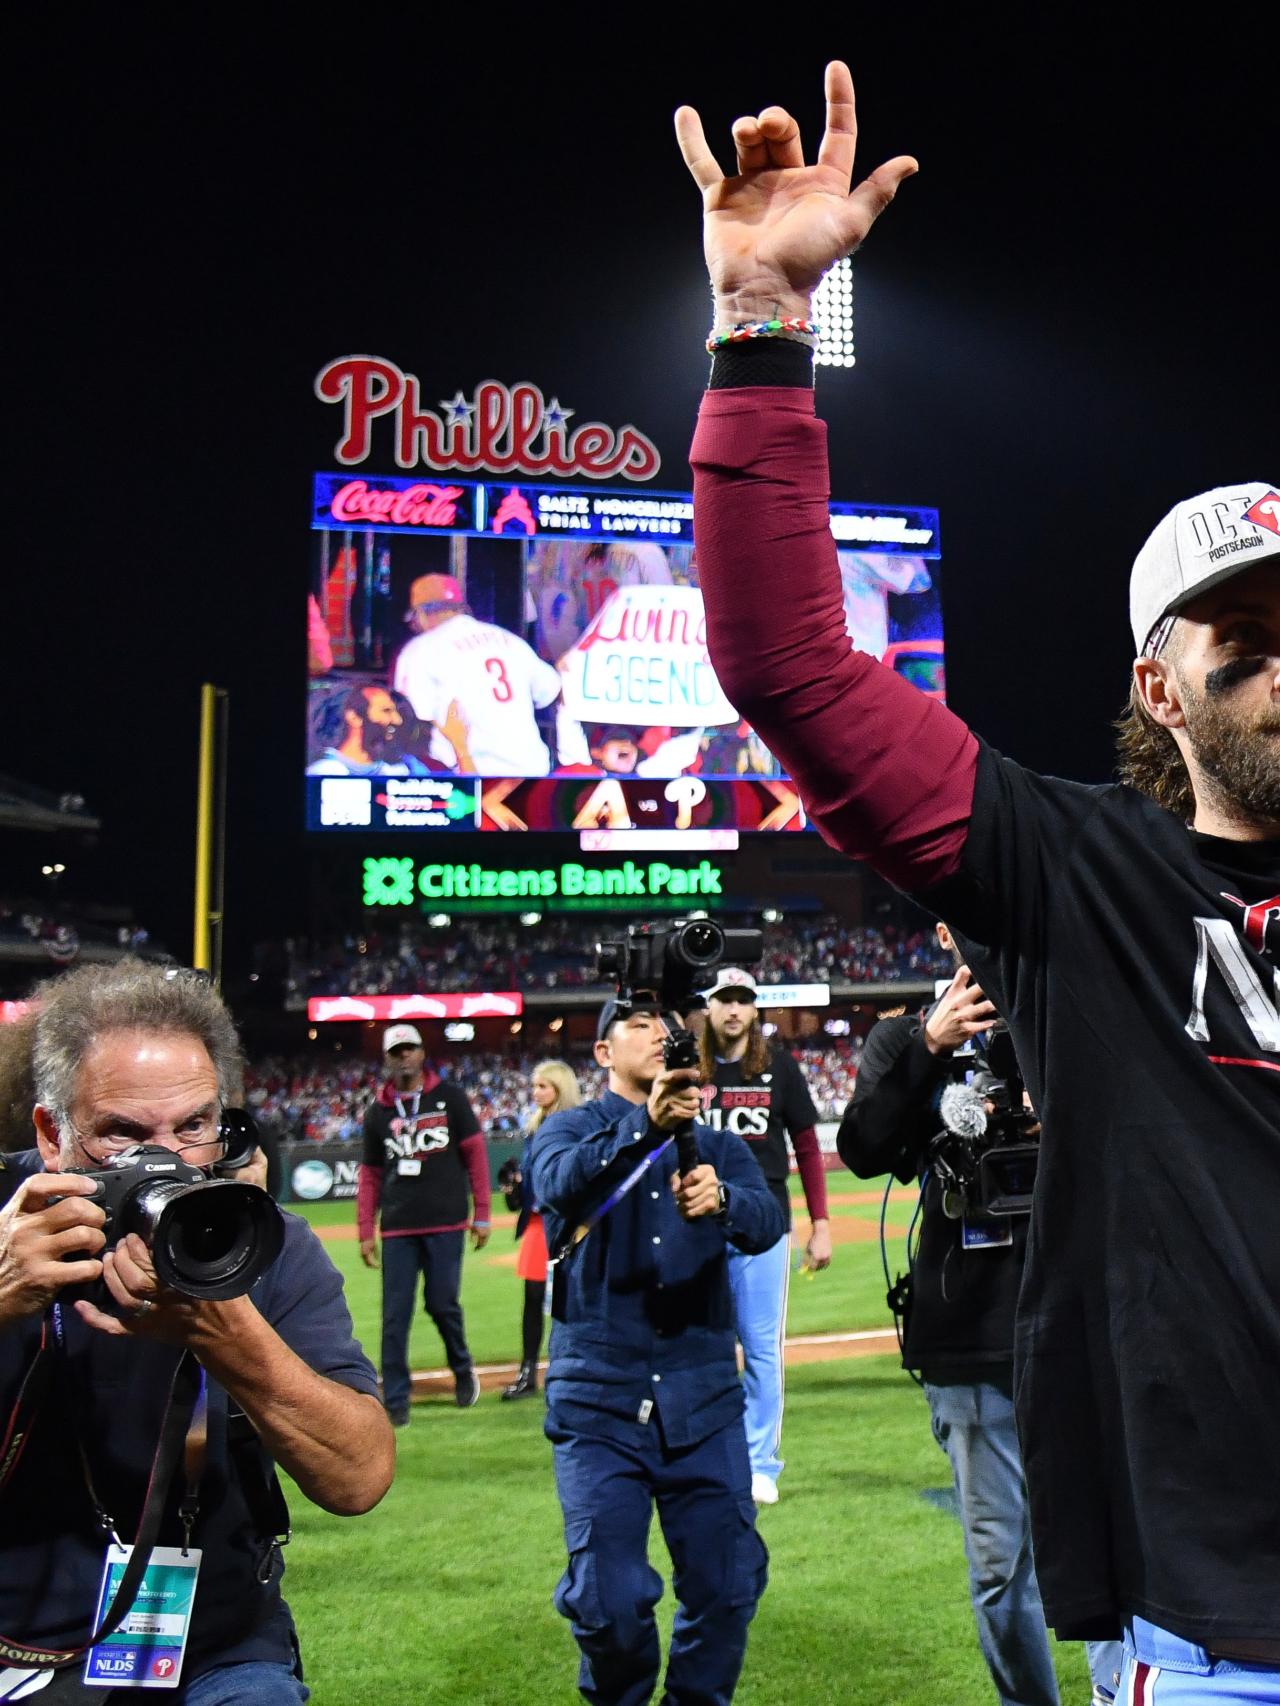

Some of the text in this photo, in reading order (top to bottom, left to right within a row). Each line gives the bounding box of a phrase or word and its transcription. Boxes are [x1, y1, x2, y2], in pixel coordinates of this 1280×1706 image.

[315, 354, 661, 481] Phillies
[1208, 535, 1264, 563] POSTSEASON
[484, 657, 514, 704] 3
[572, 778, 633, 829] A
[664, 775, 707, 830] P
[418, 861, 722, 897] Citizens Bank Park
[720, 1091, 771, 1109] 2023
[145, 1163, 177, 1172] Canon
[96, 1659, 134, 1673] NLDS
